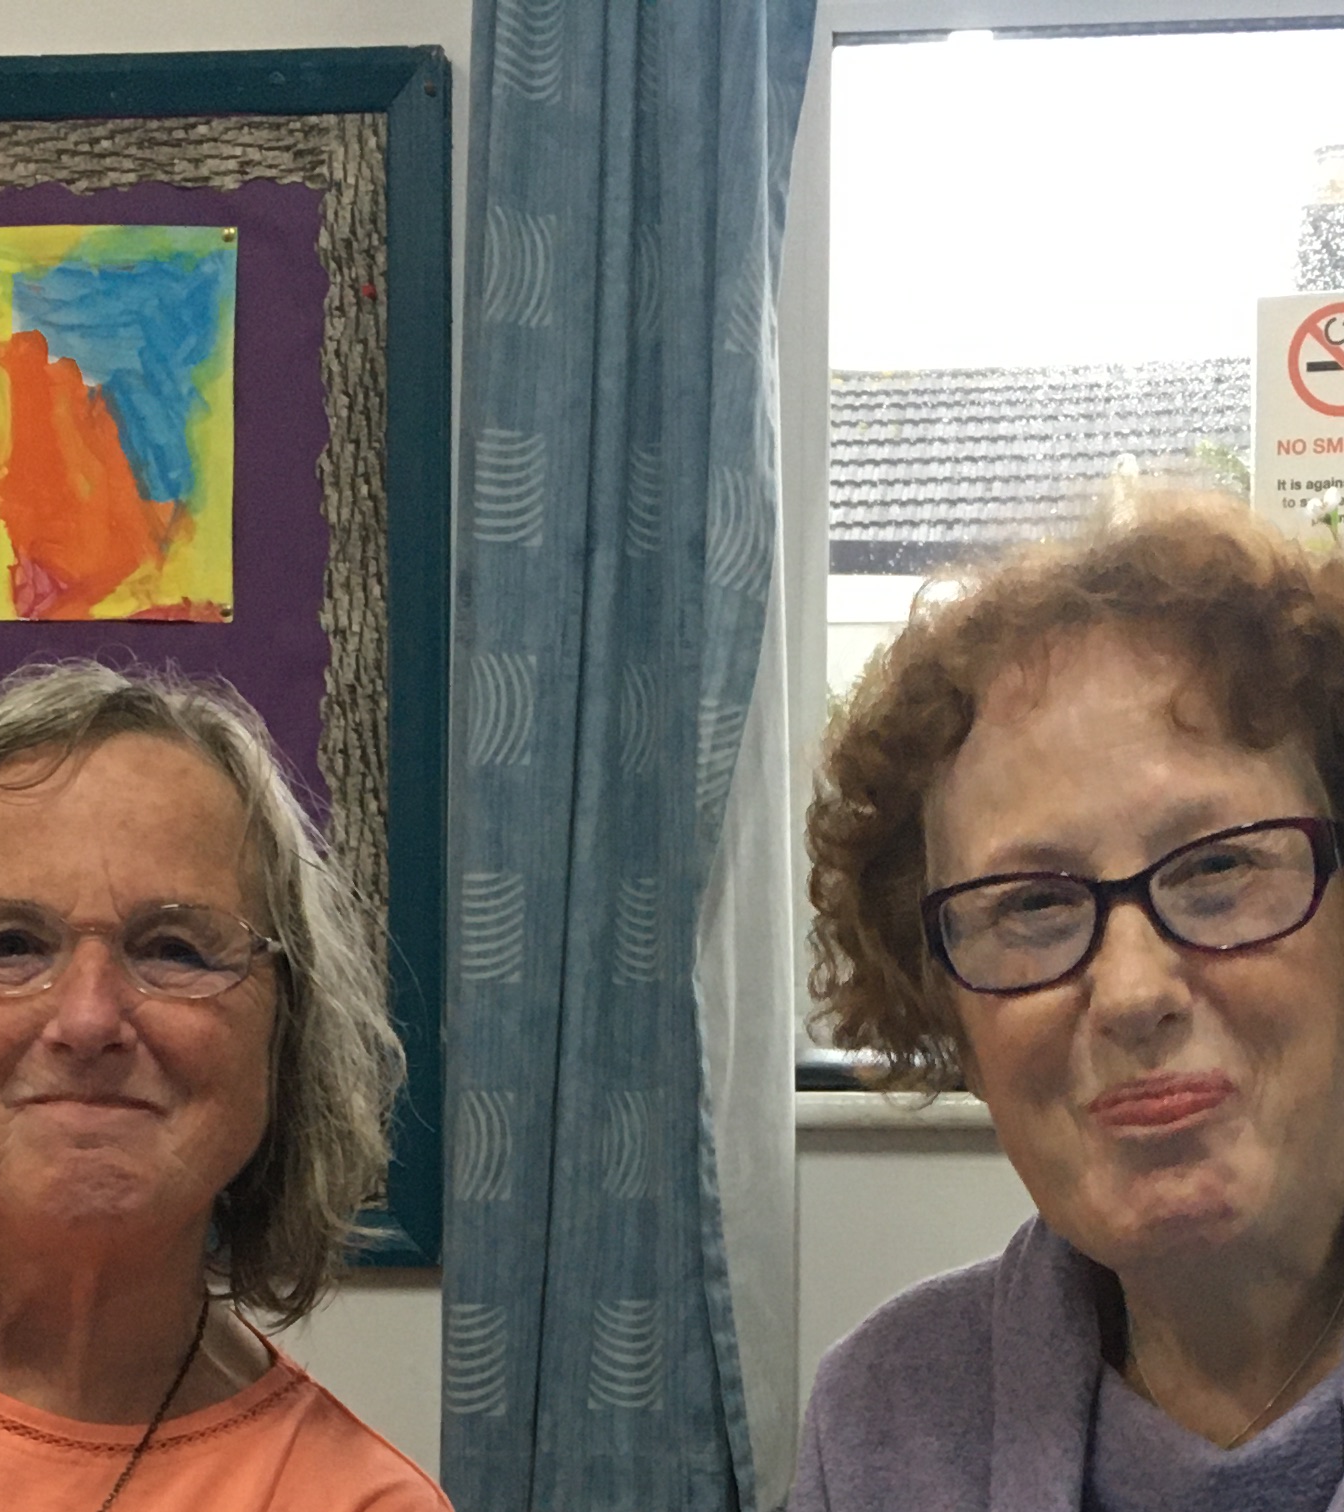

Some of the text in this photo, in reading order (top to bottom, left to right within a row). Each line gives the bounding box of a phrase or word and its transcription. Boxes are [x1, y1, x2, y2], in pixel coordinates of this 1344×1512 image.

[1277, 439, 1307, 455] NO
[1277, 480, 1286, 491] It
[1290, 479, 1302, 490] is
[1282, 497, 1296, 508] to
